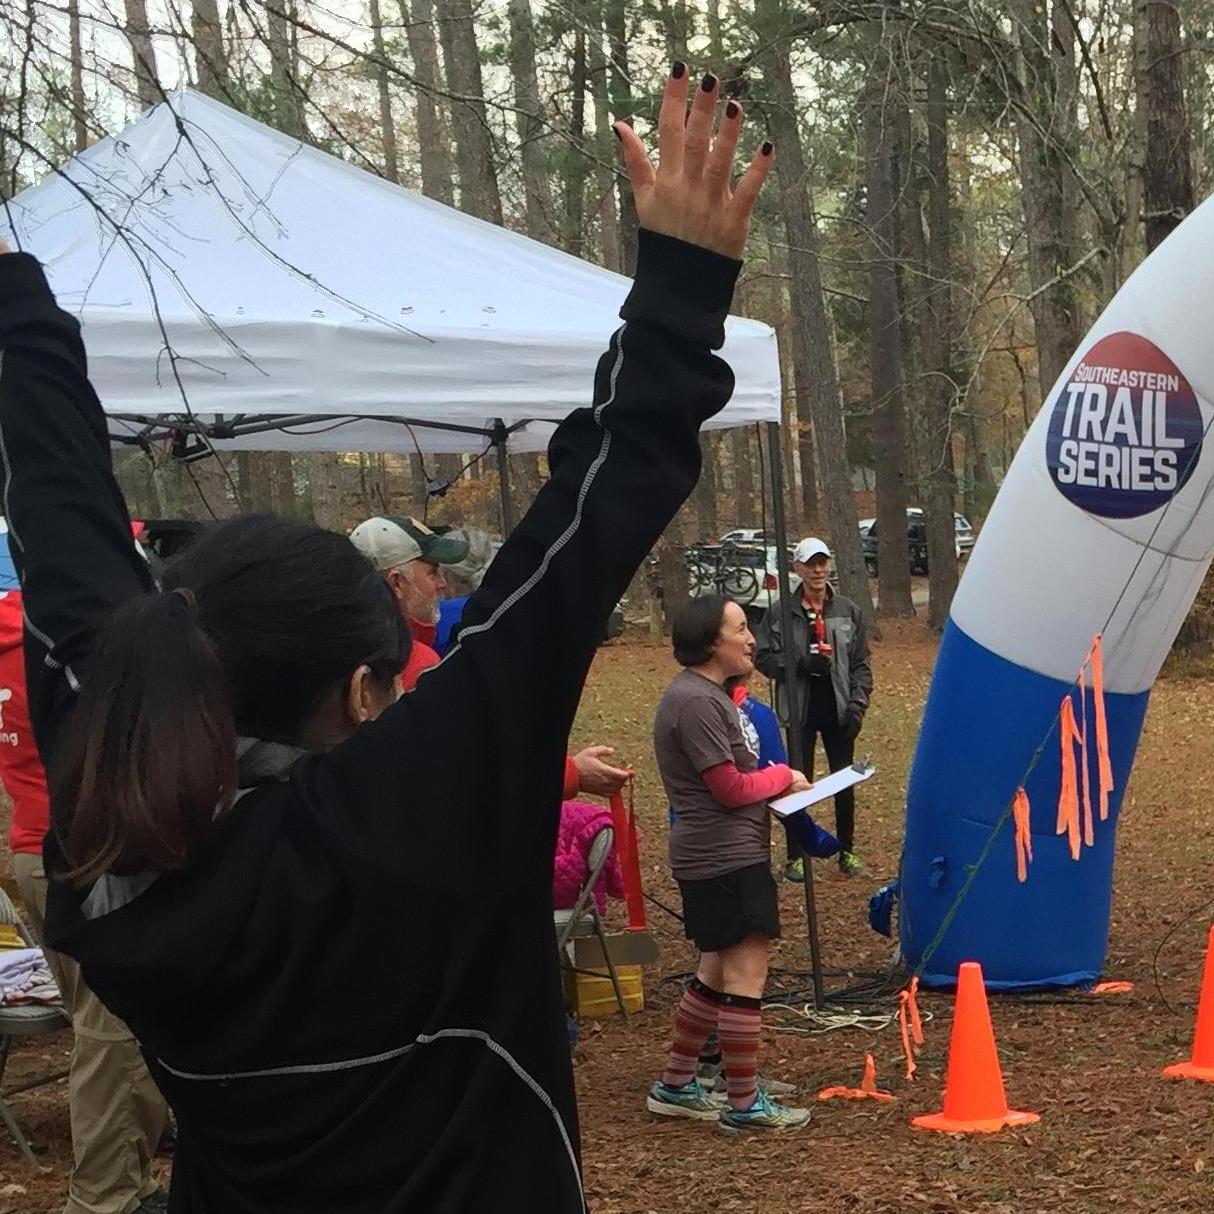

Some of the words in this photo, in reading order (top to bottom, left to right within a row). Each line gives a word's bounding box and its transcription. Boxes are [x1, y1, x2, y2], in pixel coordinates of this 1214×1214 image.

[1074, 362, 1179, 392] SOUTHEASTERN
[1062, 382, 1185, 448] TRAIL
[1057, 439, 1178, 491] SERIES
